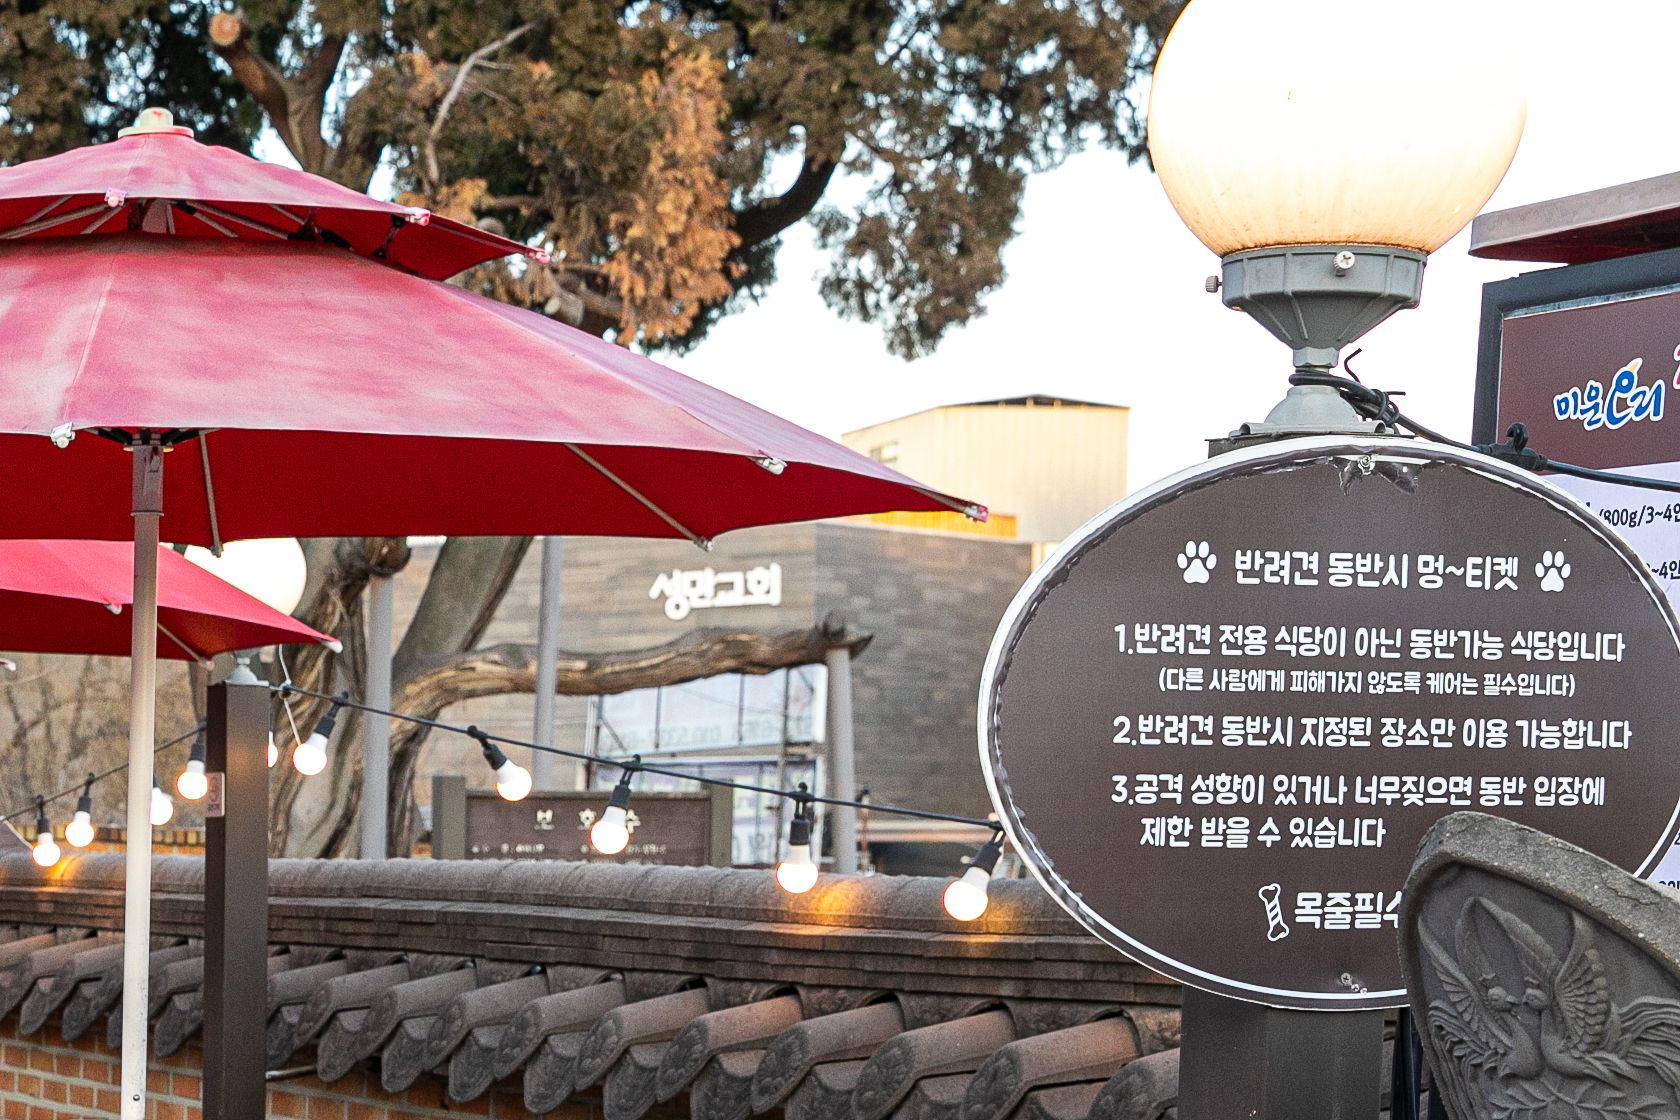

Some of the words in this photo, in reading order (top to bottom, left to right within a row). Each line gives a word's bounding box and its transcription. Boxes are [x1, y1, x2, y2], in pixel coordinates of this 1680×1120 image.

[1234, 549, 1319, 586] 반려견
[1327, 552, 1409, 589] 동반시
[1417, 554, 1519, 591] 멍~티켓
[648, 562, 782, 621] 성만교회
[1218, 624, 1268, 656] 전용
[1274, 625, 1347, 658] 식당이
[1354, 627, 1402, 659] 아닌
[1409, 628, 1505, 661] 동반가능
[1510, 630, 1626, 663] 식당입니다
[1158, 666, 1205, 692] (다른
[1208, 668, 1286, 693] 사람에게
[1289, 669, 1363, 694] 피해가지
[1367, 670, 1422, 695] 않도록
[1425, 672, 1479, 696] 케어는
[1483, 672, 1576, 698] 필수입니다)
[1221, 715, 1294, 748] 동반시
[1299, 716, 1372, 748] 지정된
[1380, 717, 1457, 748] 장소만
[1462, 718, 1509, 749] 이용
[1515, 717, 1633, 750] 가능합니다
[1190, 772, 1265, 805] 성향이
[1272, 774, 1348, 806] 있거나
[1354, 774, 1473, 807] 너무짖으면
[1478, 776, 1528, 807] 동반
[1533, 775, 1605, 807] 입장에
[1139, 815, 1194, 848] 제한
[1200, 816, 1251, 849] 받을
[1256, 816, 1282, 848] 수
[1289, 816, 1387, 849] 있습니다
